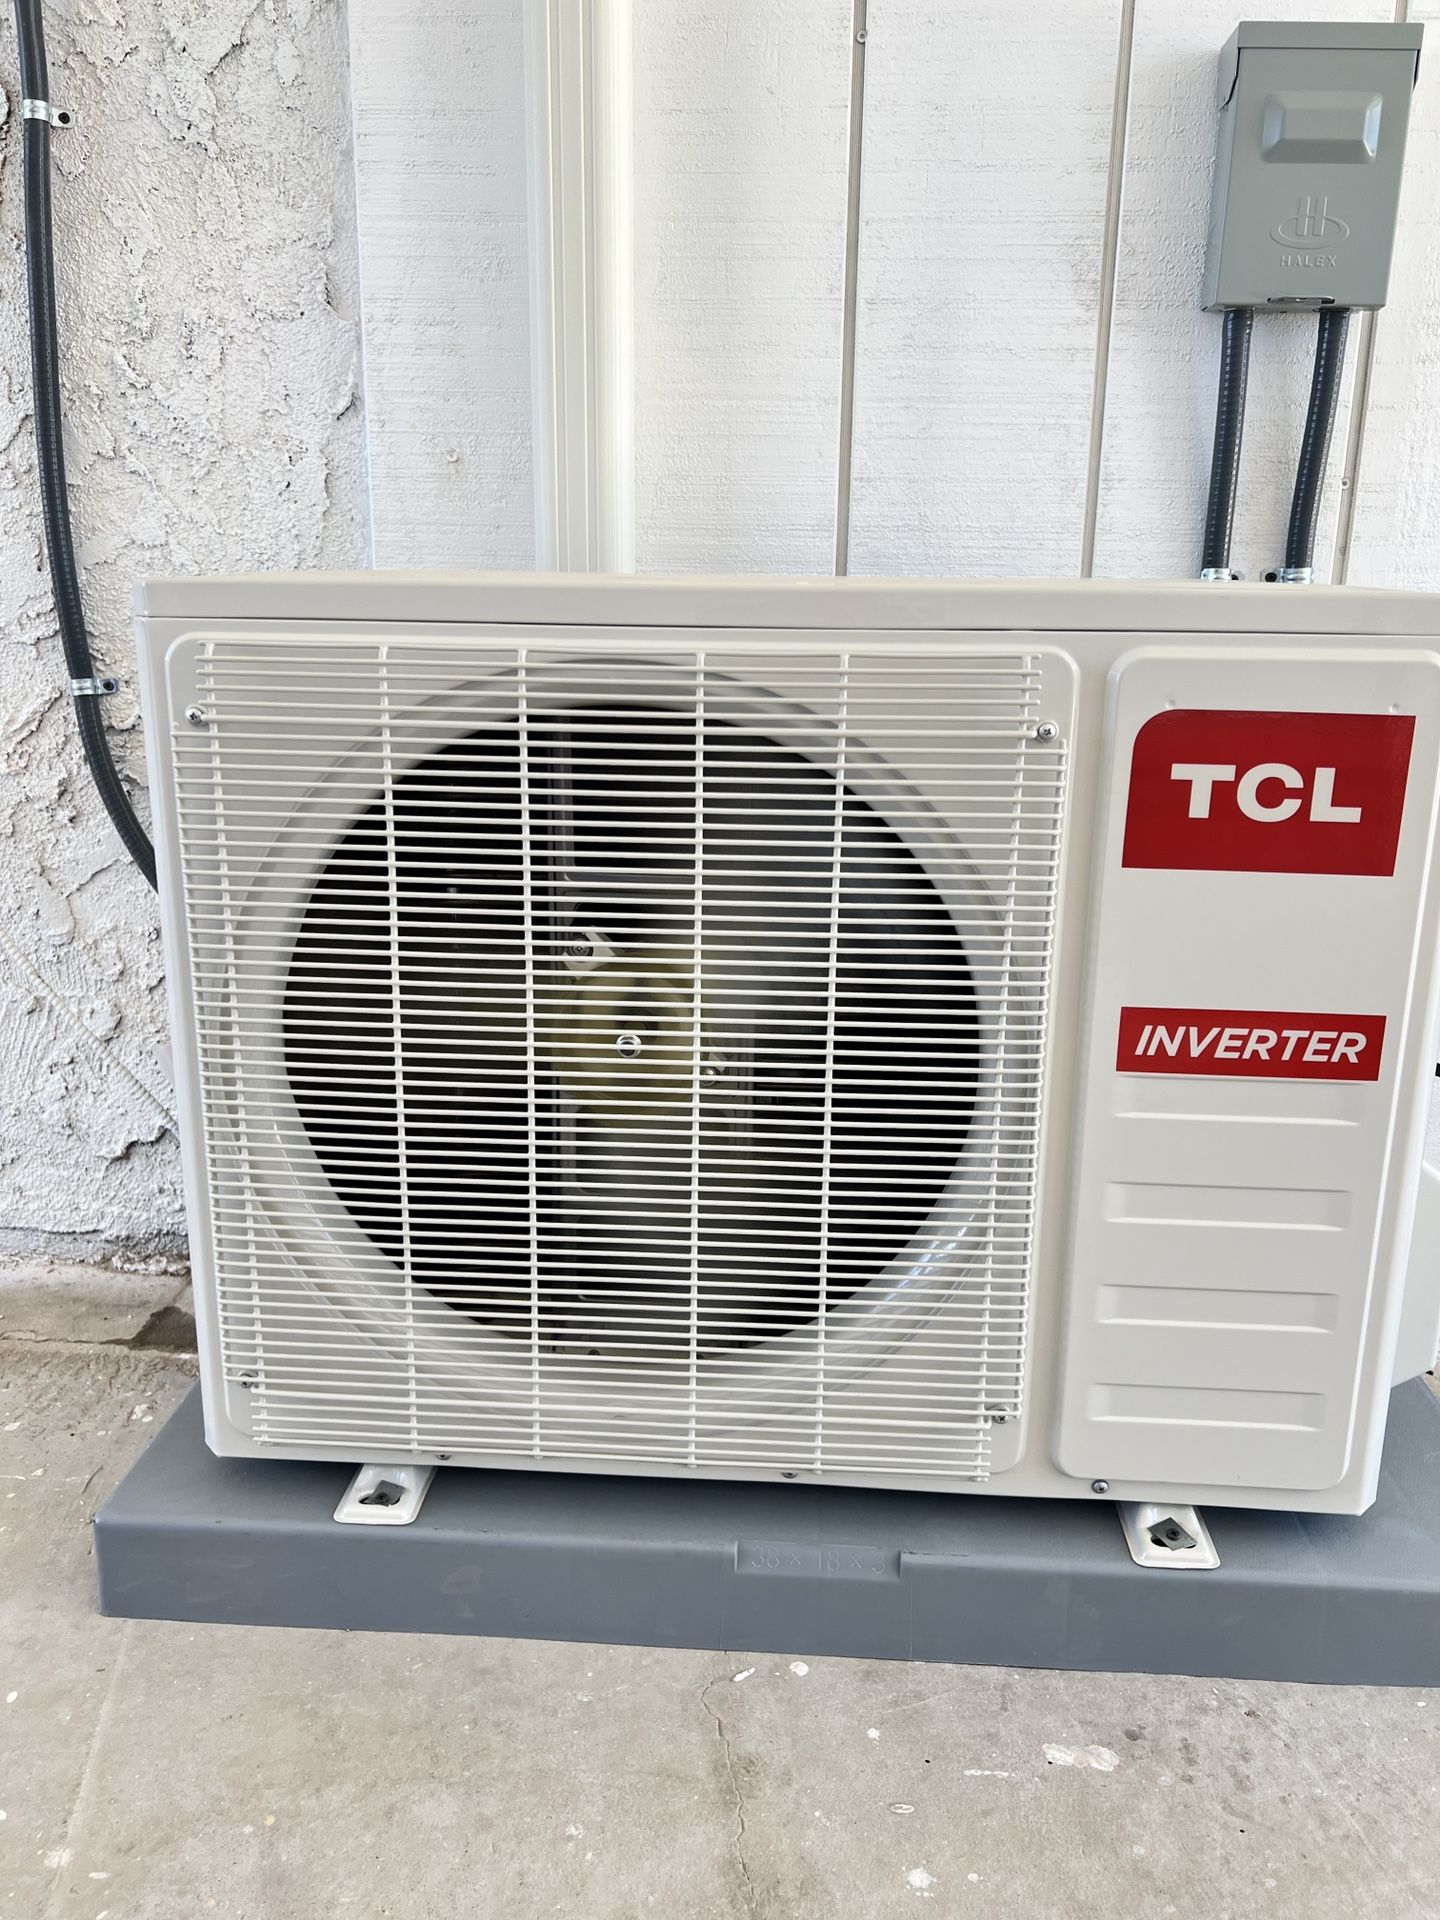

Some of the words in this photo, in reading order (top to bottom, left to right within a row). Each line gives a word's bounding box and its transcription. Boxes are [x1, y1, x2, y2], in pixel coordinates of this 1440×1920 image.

[1280, 255, 1337, 268] HALEX
[1170, 763, 1362, 823] TCL
[1134, 1025, 1367, 1064] INVERTER
[871, 1551, 886, 1574] 3
